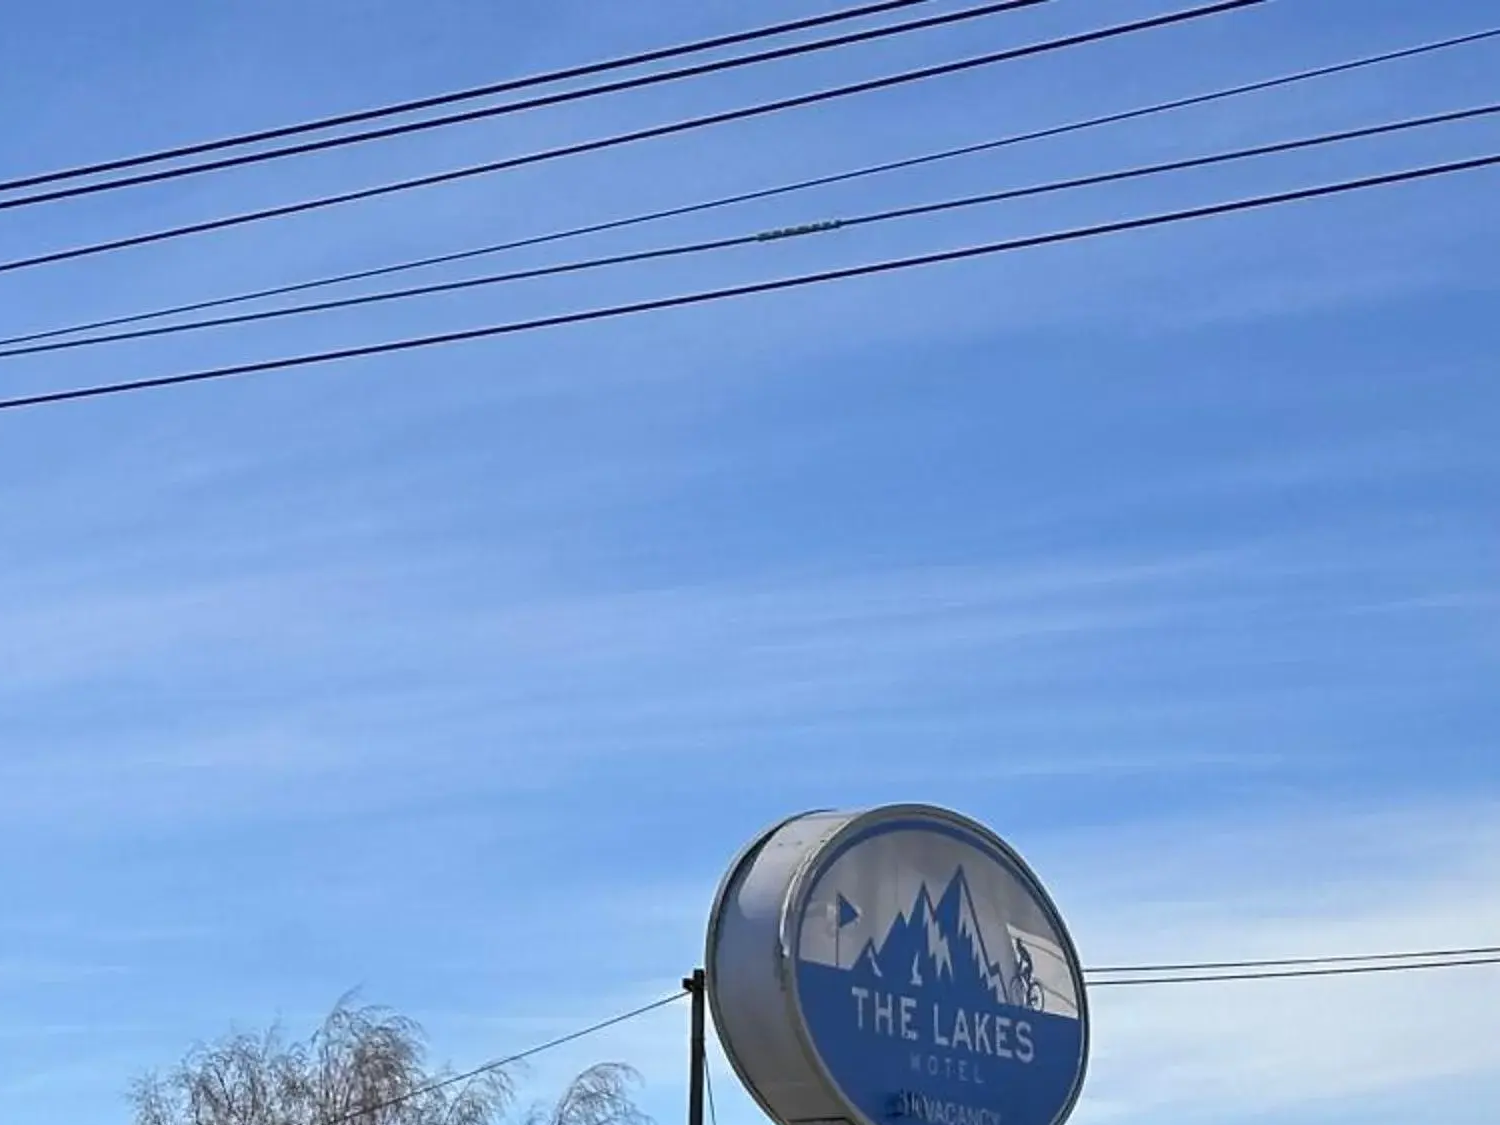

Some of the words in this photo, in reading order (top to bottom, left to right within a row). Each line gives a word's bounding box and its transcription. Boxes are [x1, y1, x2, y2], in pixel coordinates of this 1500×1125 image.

[851, 986, 918, 1040] THE
[933, 1002, 1035, 1063] LAKES
[911, 1052, 984, 1083] MOTEL
